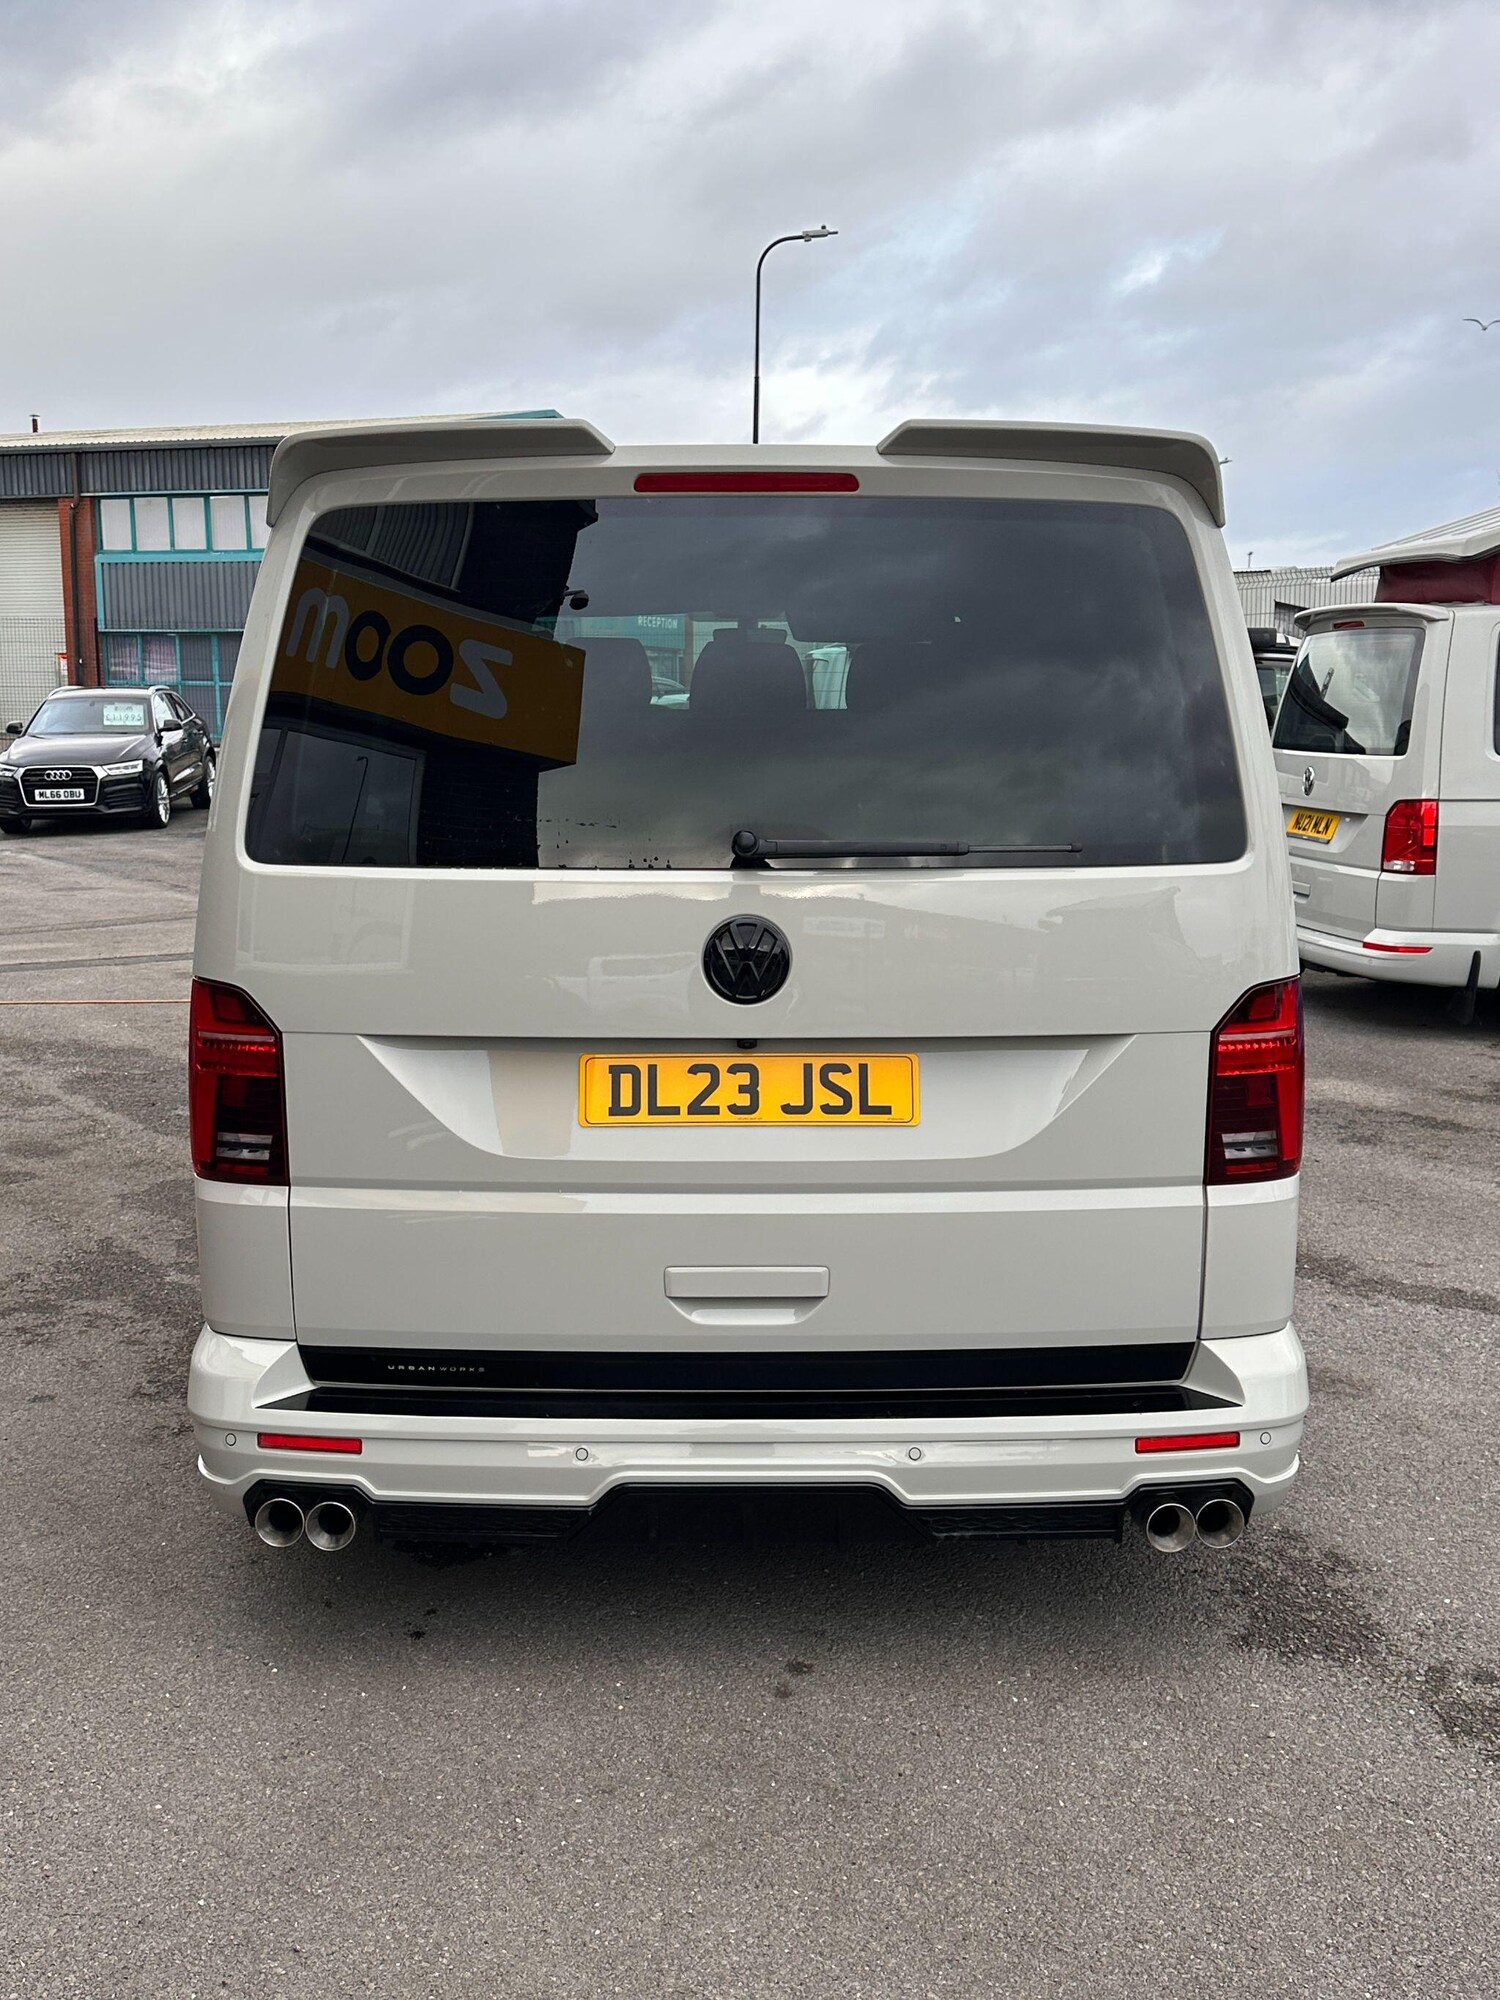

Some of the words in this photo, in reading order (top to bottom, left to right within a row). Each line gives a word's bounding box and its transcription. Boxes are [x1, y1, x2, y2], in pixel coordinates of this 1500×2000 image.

[637, 615, 678, 629] RECEPTION
[38, 790, 62, 799] ML66
[1292, 812, 1313, 832] NU21
[1311, 814, 1334, 836] MLN
[608, 1064, 760, 1117] DL23
[780, 1063, 892, 1115] JSL
